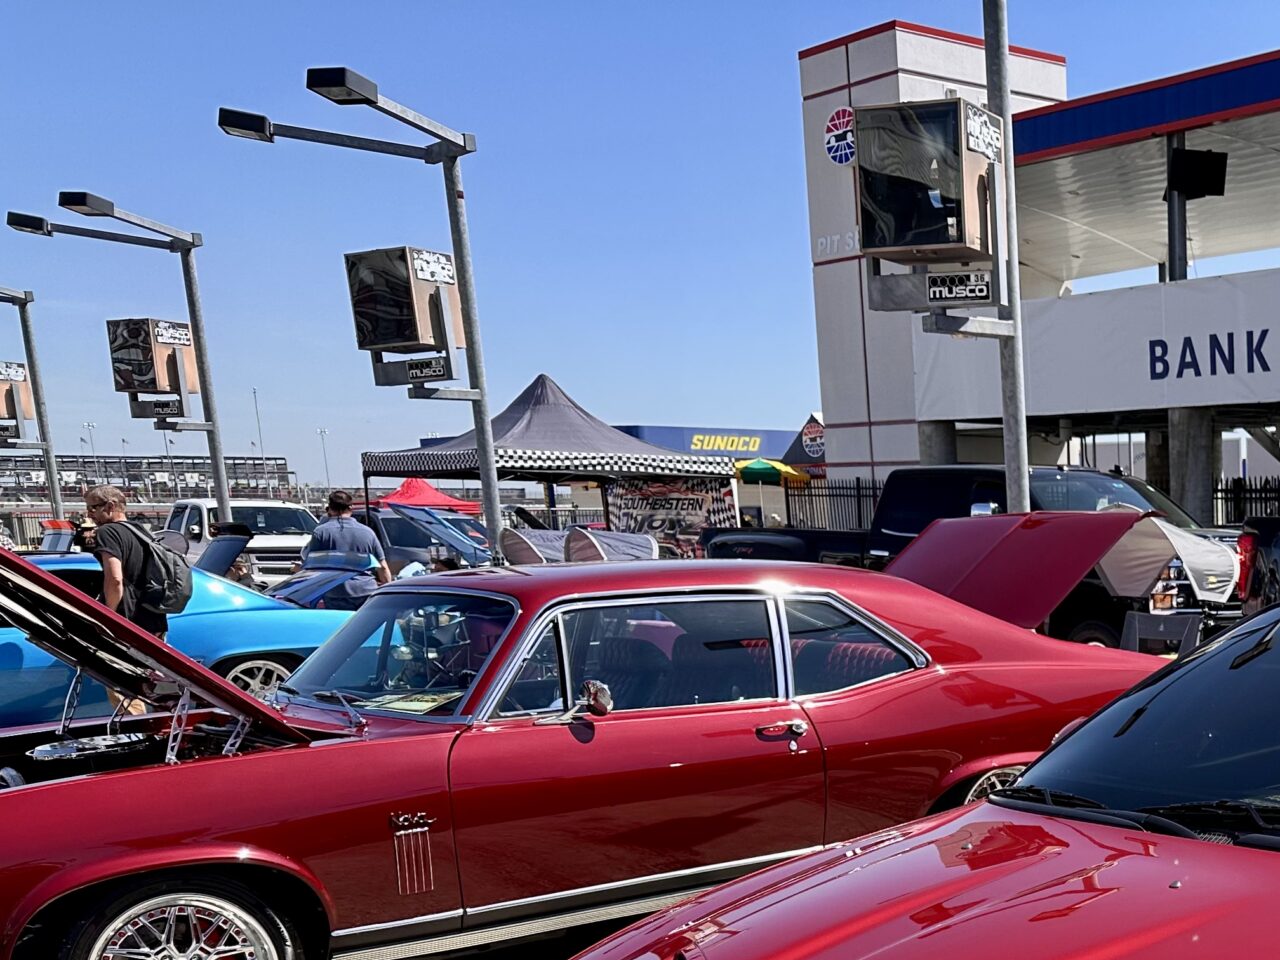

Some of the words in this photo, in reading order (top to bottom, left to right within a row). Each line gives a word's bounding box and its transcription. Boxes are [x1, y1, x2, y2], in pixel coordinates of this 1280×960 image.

[1149, 328, 1271, 380] BANK
[690, 434, 761, 452] SUNOCO
[622, 497, 704, 511] SOUTHEASTERN
